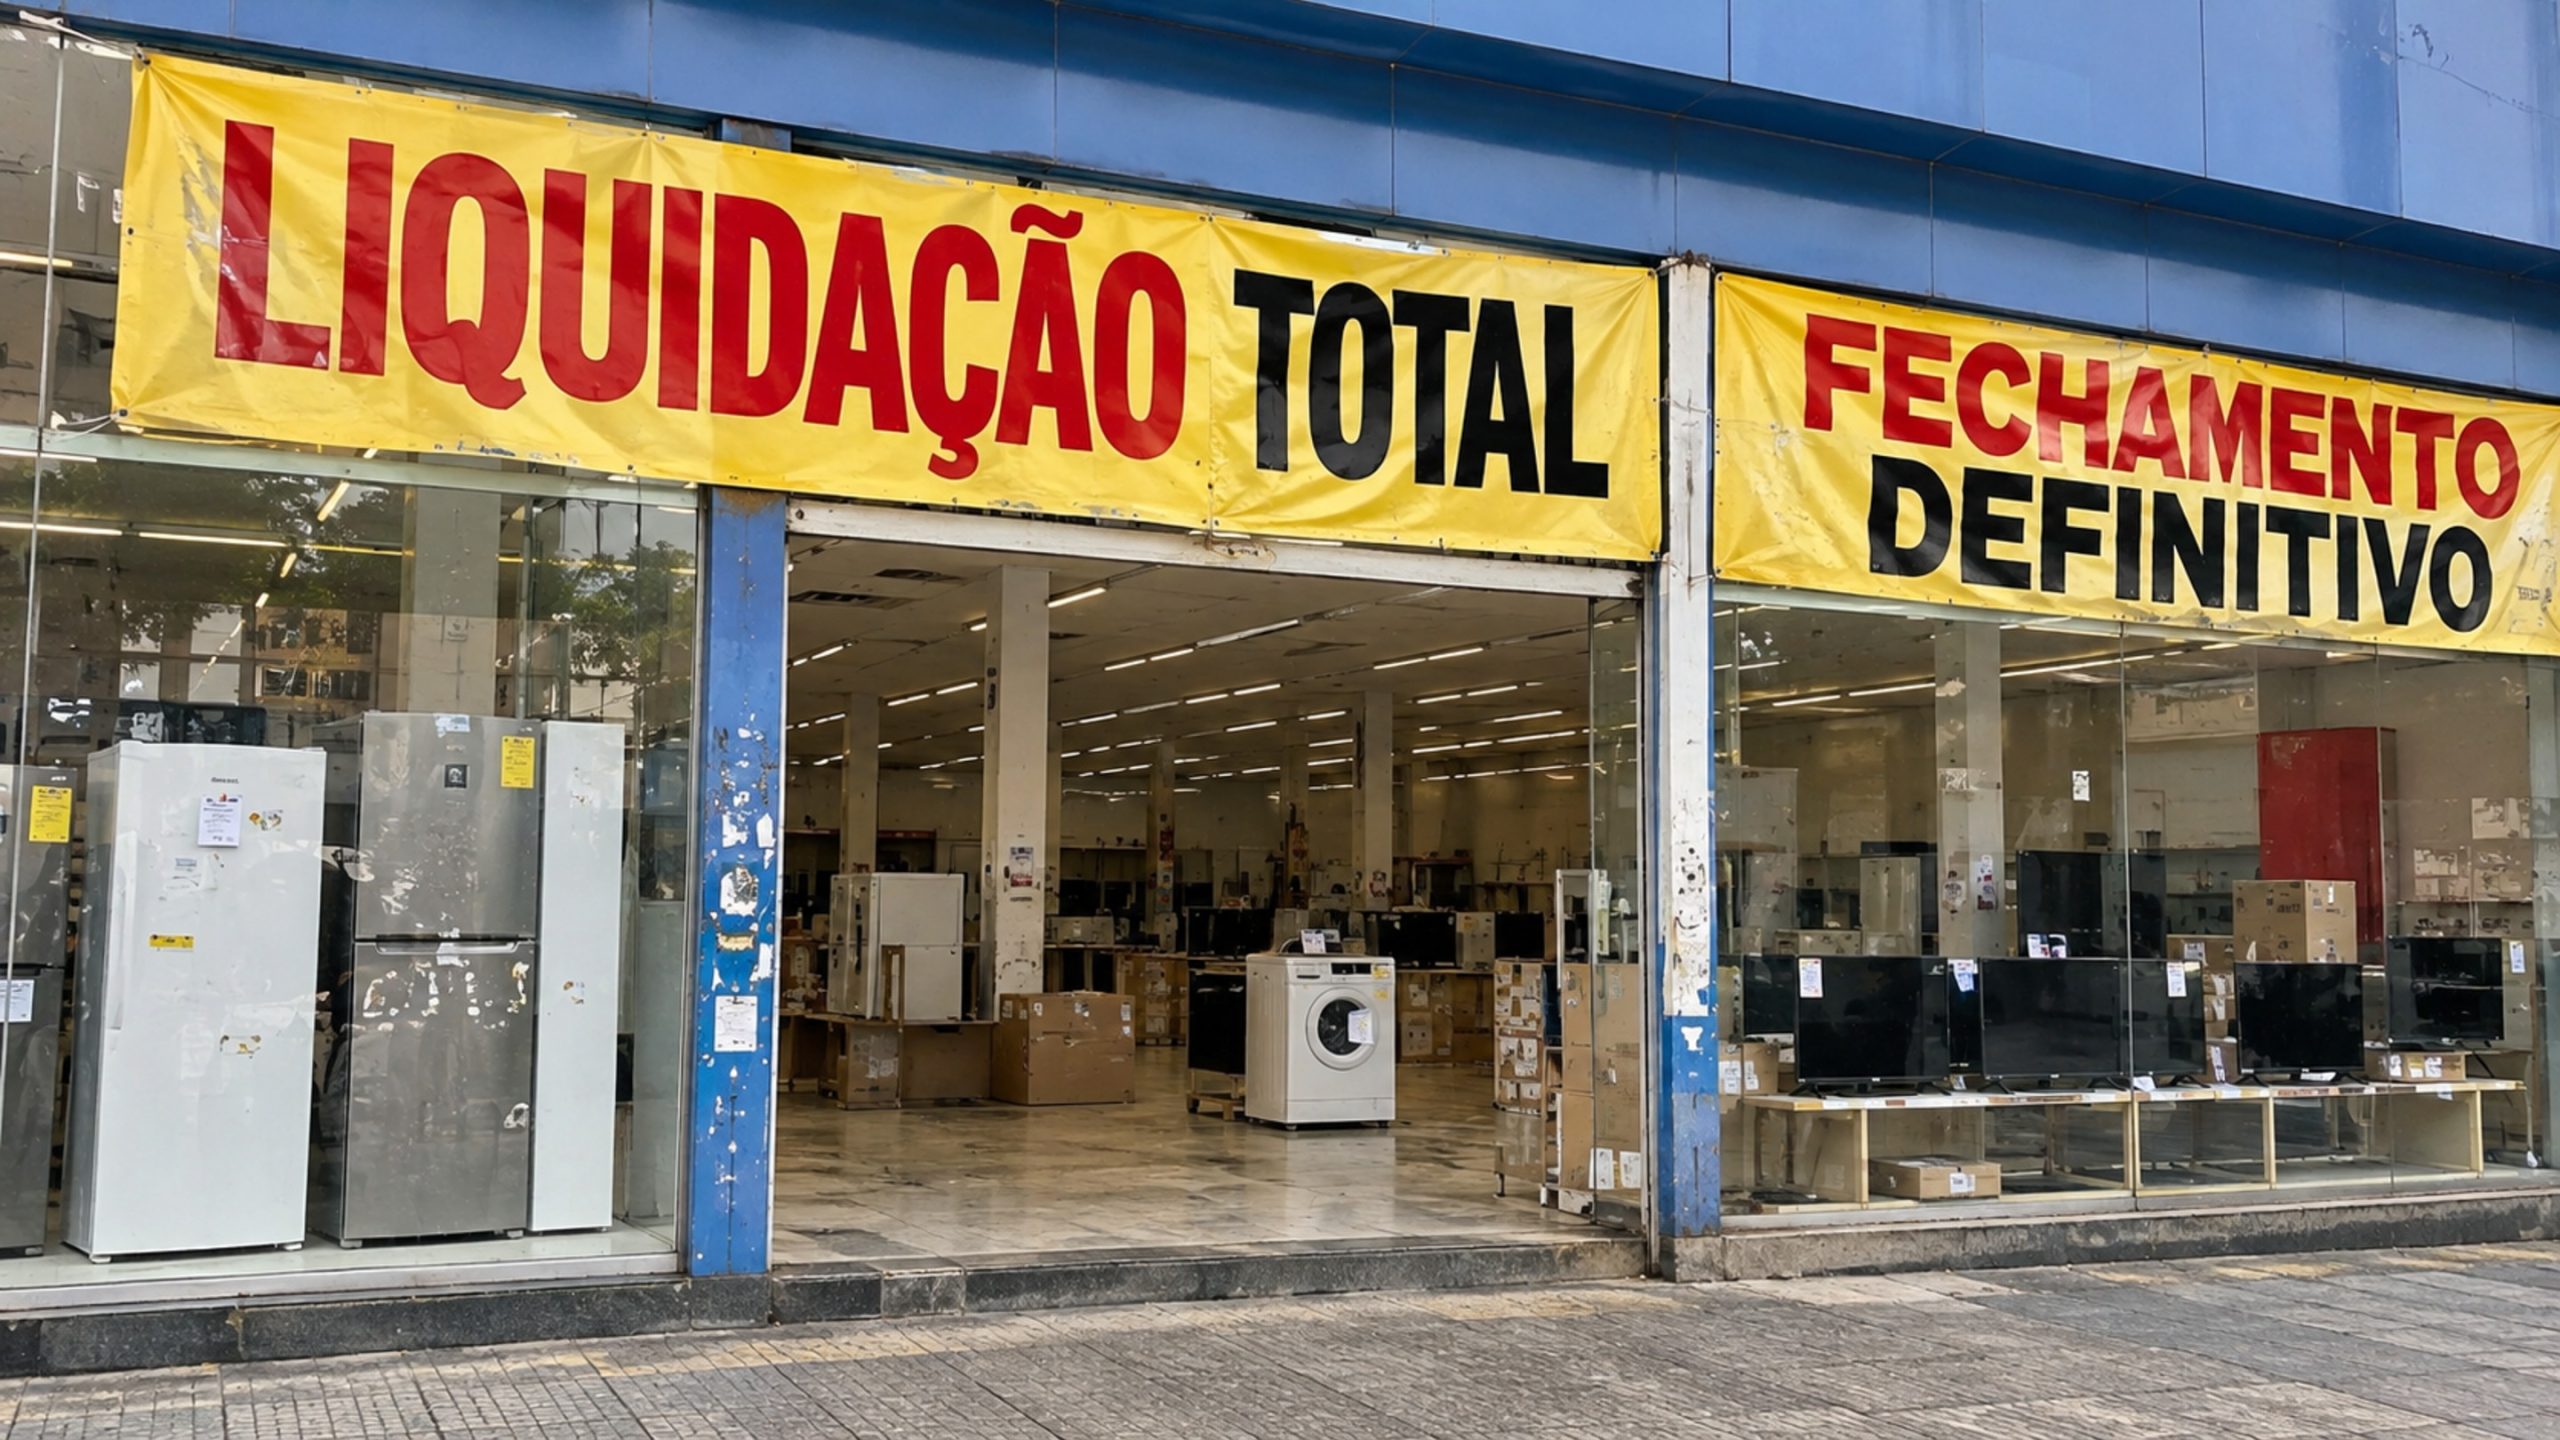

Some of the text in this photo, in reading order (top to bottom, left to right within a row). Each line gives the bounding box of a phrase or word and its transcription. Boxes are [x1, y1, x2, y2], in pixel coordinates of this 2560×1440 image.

[215, 120, 1609, 498] LIQUIDAÇÃO TOTAL
[1804, 313, 2521, 519] FECHAMENTO
[1867, 454, 2492, 632] DEFINITIVO
